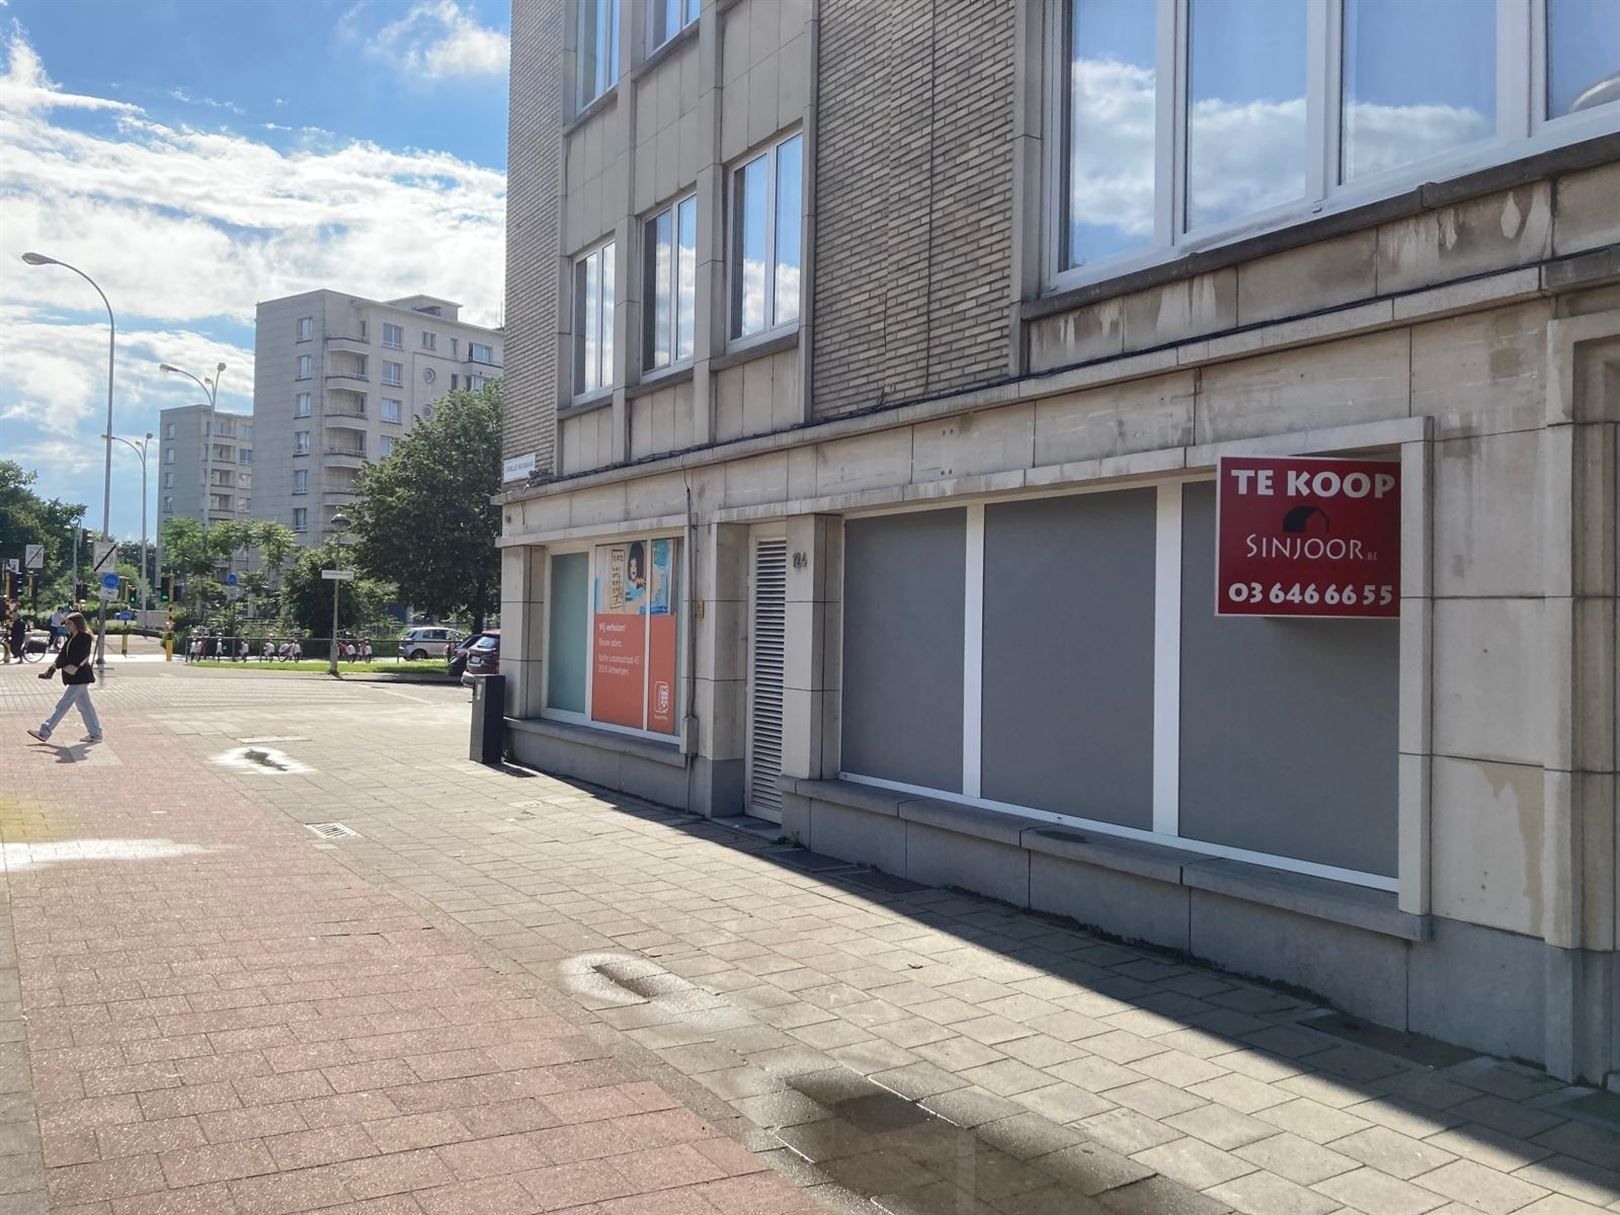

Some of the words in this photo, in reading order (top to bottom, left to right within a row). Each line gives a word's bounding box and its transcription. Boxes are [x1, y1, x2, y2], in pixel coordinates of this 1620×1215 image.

[1231, 469, 1274, 495] TE
[1287, 470, 1396, 499] KOOP
[1228, 582, 1263, 603] 03
[1269, 582, 1319, 605] 646
